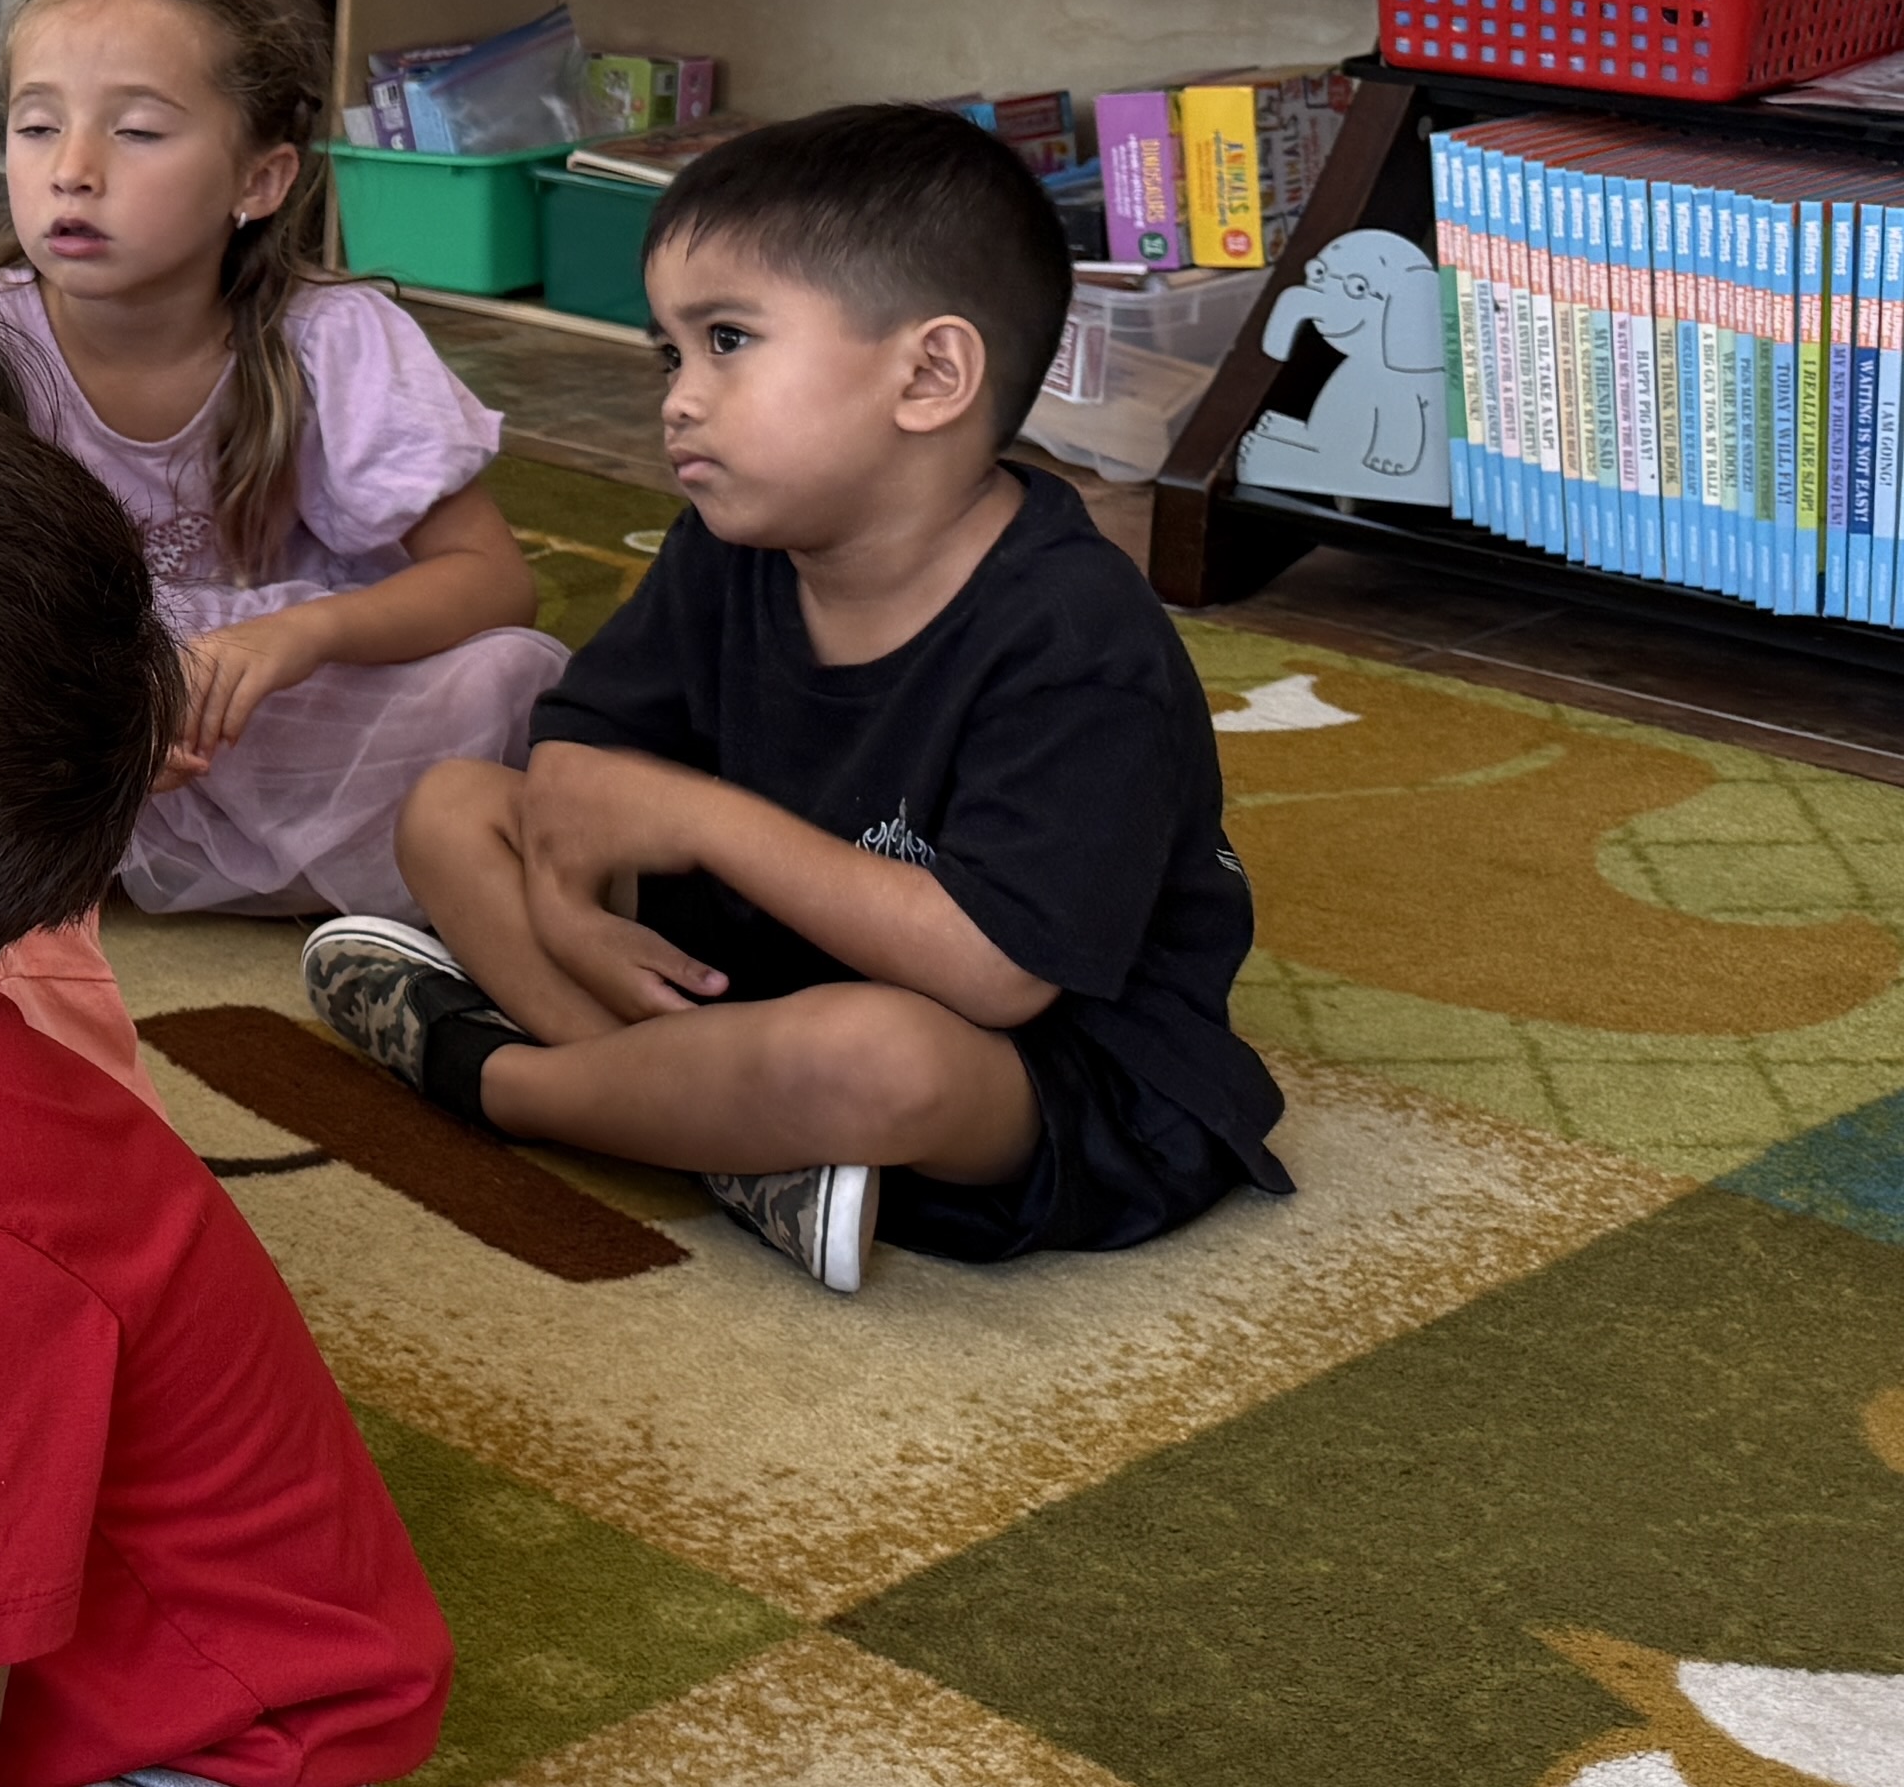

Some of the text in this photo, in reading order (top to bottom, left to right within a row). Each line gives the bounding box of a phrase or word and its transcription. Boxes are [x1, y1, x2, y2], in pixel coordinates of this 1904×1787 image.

[1862, 224, 1880, 280] Willems
[1886, 226, 1903, 282] Willems
[1703, 332, 1714, 340] A
[1703, 344, 1715, 366] BIG
[1594, 328, 1614, 470] MY FRIEND IS SAD
[1636, 350, 1653, 461] HAPPY PIG DAY!
[1704, 369, 1716, 394] GUY
[1777, 362, 1791, 413] TODAY
[1801, 369, 1817, 429] REALLY
[1659, 330, 1678, 485] THE THANK YOU BOOK
[1705, 399, 1717, 433] TOOK
[1723, 350, 1737, 488] WE ARE IN A BOOK!
[1881, 412, 1895, 432] AM
[1705, 437, 1717, 457] MY
[1777, 427, 1792, 468] WILL
[1801, 432, 1815, 467] LIKE
[1830, 347, 1846, 525] MY NEW FRIEND IS SO FUN!
[1854, 360, 1875, 523] WAITING IS NOT EASY!
[1879, 436, 1894, 487] GOING!
[1778, 472, 1792, 505] FLY!
[1800, 470, 1815, 512] SLOP!
